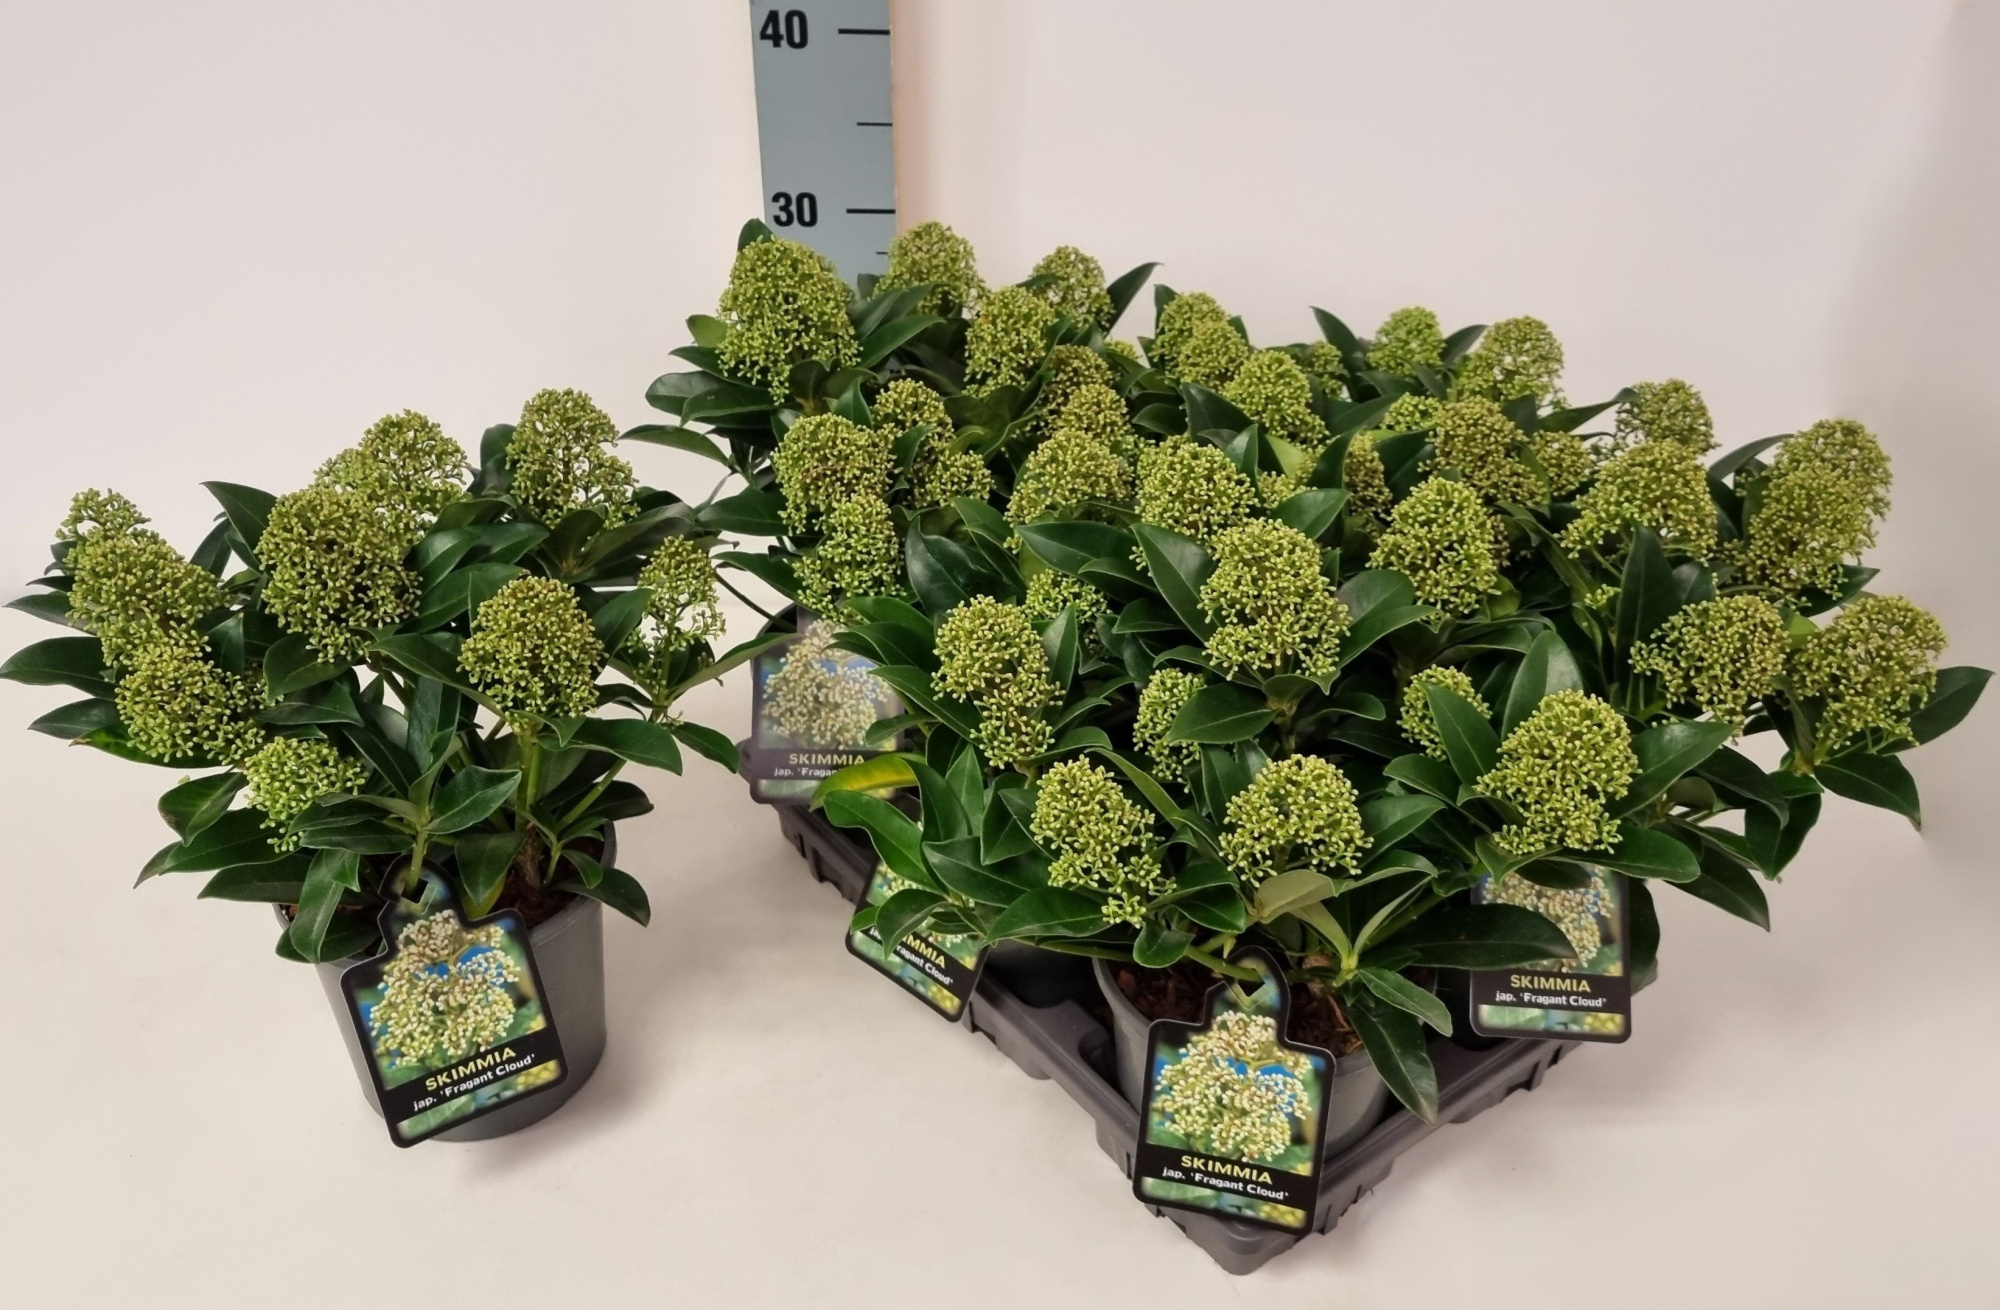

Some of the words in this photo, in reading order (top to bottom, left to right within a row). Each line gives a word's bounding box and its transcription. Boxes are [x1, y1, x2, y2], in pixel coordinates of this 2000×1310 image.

[759, 9, 809, 49] 40
[771, 191, 818, 228] 30
[789, 753, 866, 766] SKIMMIA
[774, 767, 794, 777] jap.
[1510, 974, 1592, 993] SKIMMIA
[1495, 991, 1516, 1002] jap.
[425, 1047, 516, 1092] SKIMMIA
[413, 1096, 437, 1111] jap.
[1162, 1167, 1186, 1180] jap.
[1181, 1155, 1274, 1185] SKIMMIA
